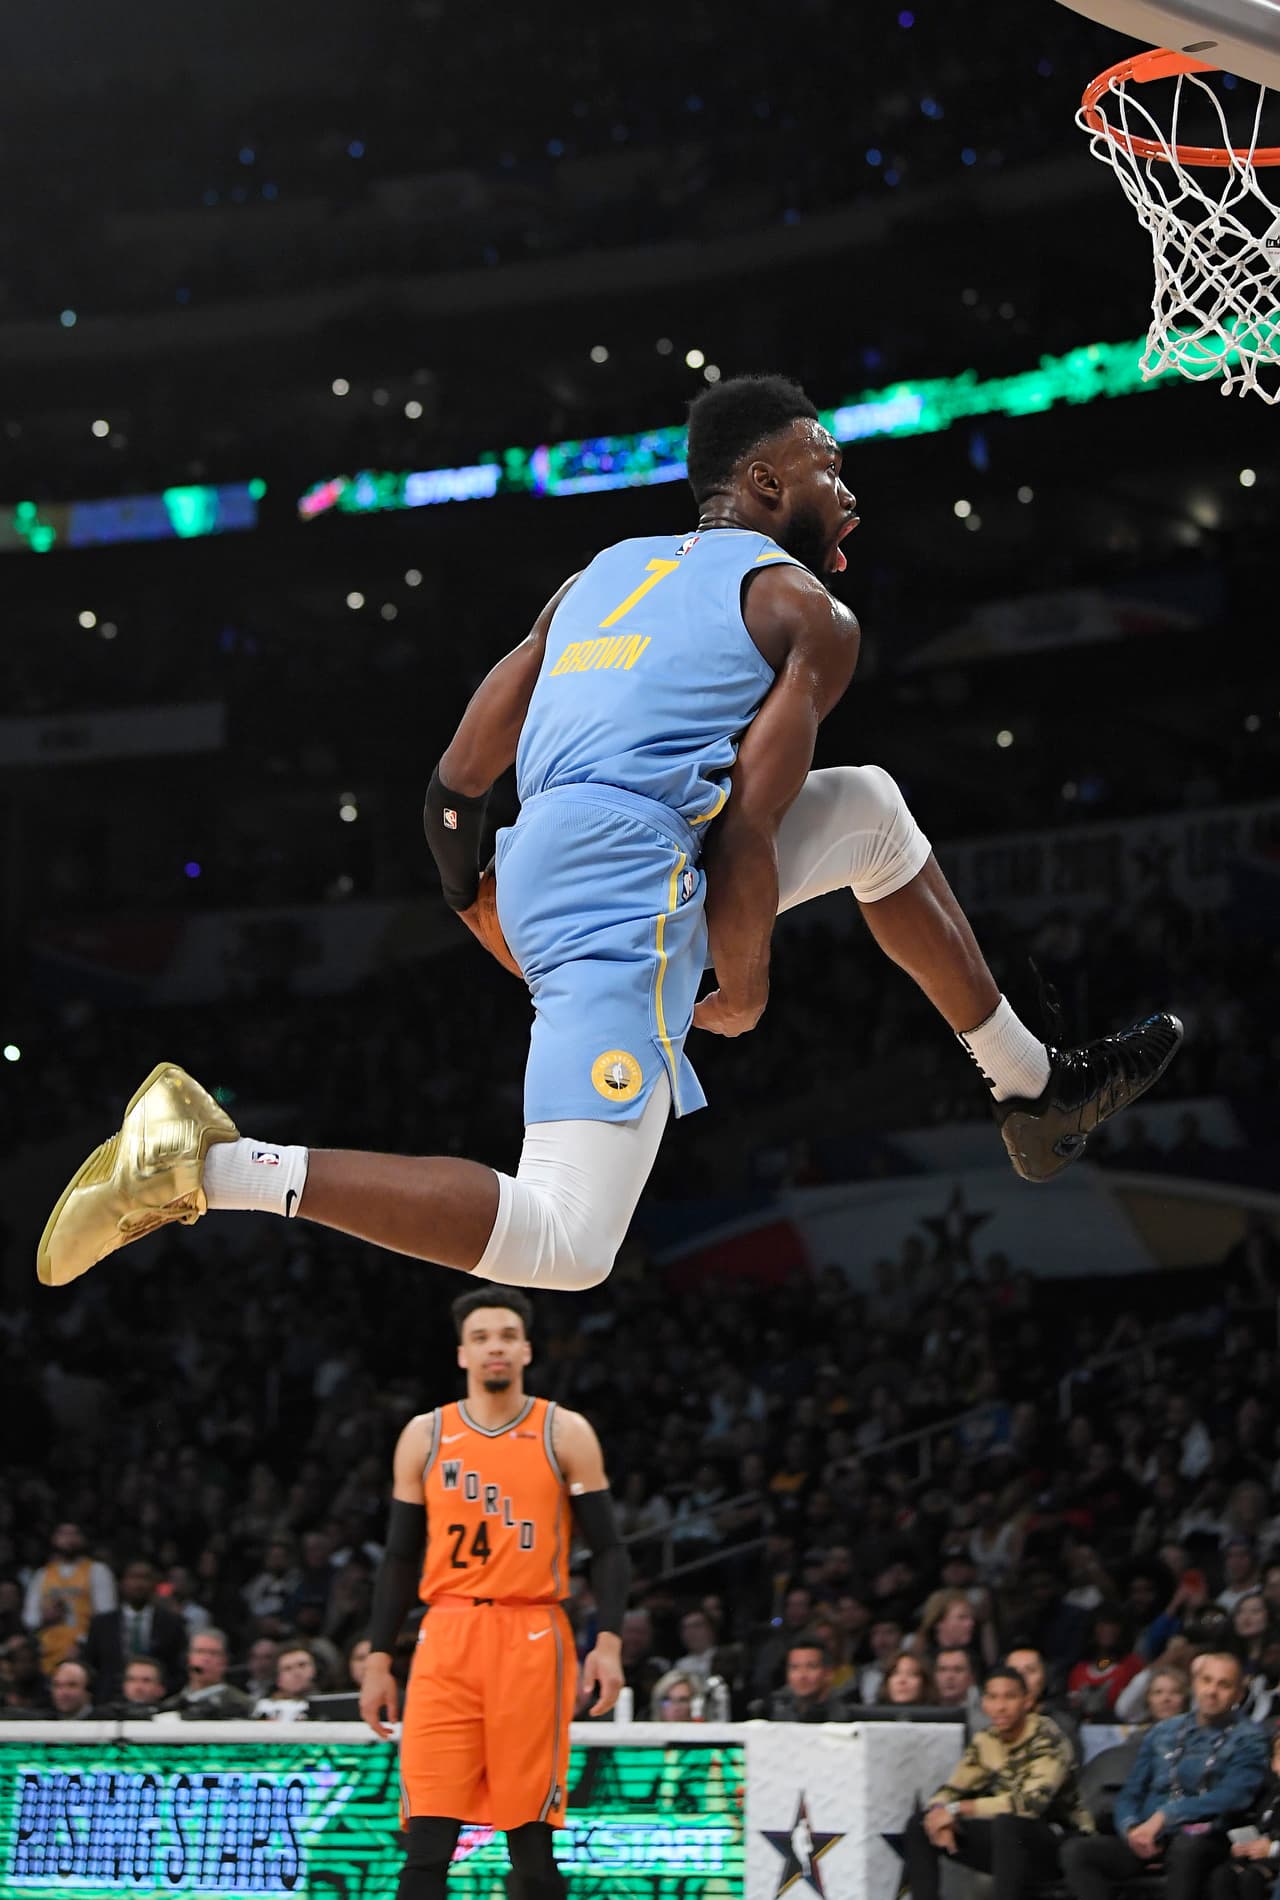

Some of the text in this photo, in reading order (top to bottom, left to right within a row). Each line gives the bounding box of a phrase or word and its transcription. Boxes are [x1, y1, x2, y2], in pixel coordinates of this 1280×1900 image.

[598, 557, 681, 629] 7
[549, 634, 652, 677] BROWN
[441, 1459, 536, 1552] WORLD
[447, 1520, 492, 1570] 24
